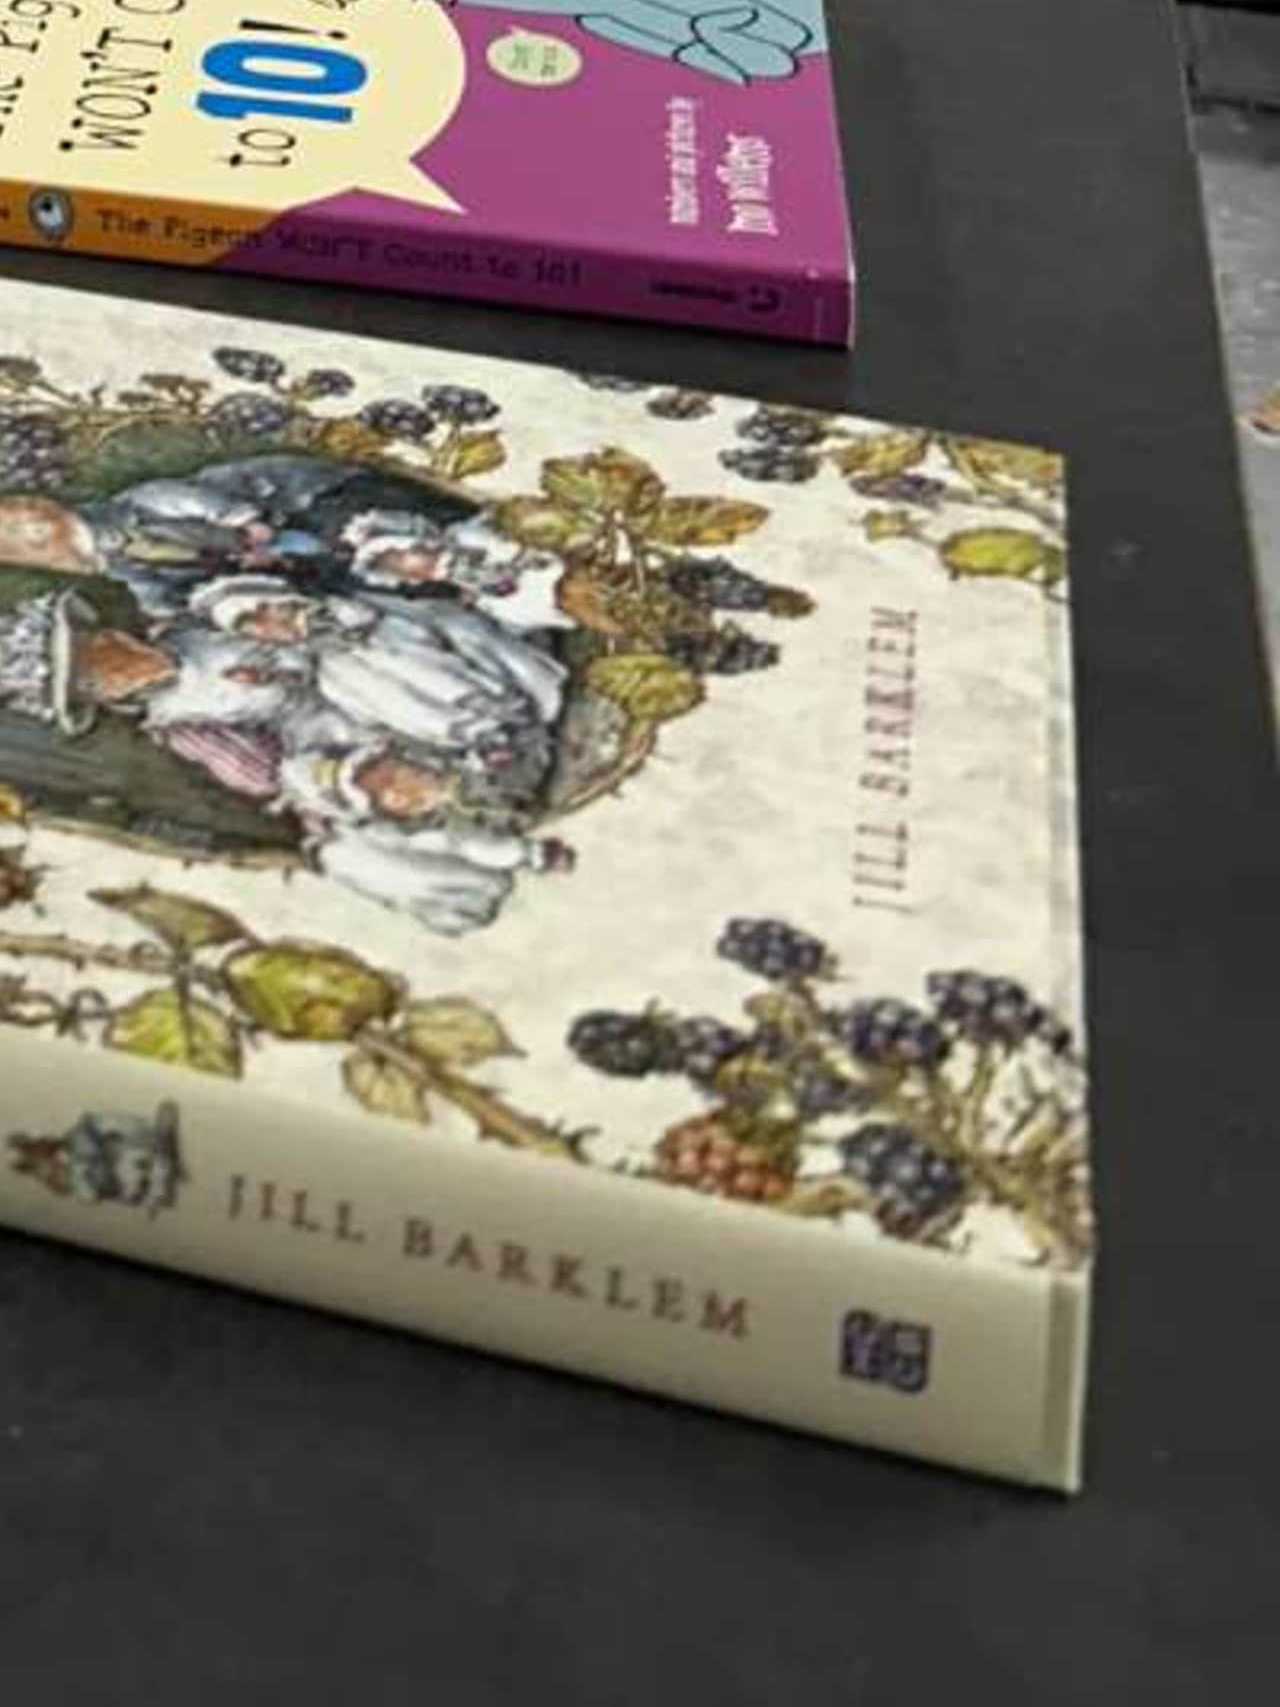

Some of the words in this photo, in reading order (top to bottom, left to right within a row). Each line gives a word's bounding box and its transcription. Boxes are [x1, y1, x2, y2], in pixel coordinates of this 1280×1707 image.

[58, 27, 173, 153] WON'T
[194, 18, 367, 123] 10!
[226, 125, 297, 169] to
[95, 208, 148, 235] The
[162, 215, 262, 250] Pigeon
[383, 242, 476, 278] Count
[487, 257, 521, 282] to
[533, 261, 582, 287] 10!
[858, 605, 919, 799] BARKLEM
[852, 819, 921, 916] JILL
[226, 1173, 366, 1246] JILL
[400, 1216, 752, 1340] BARKLEM
